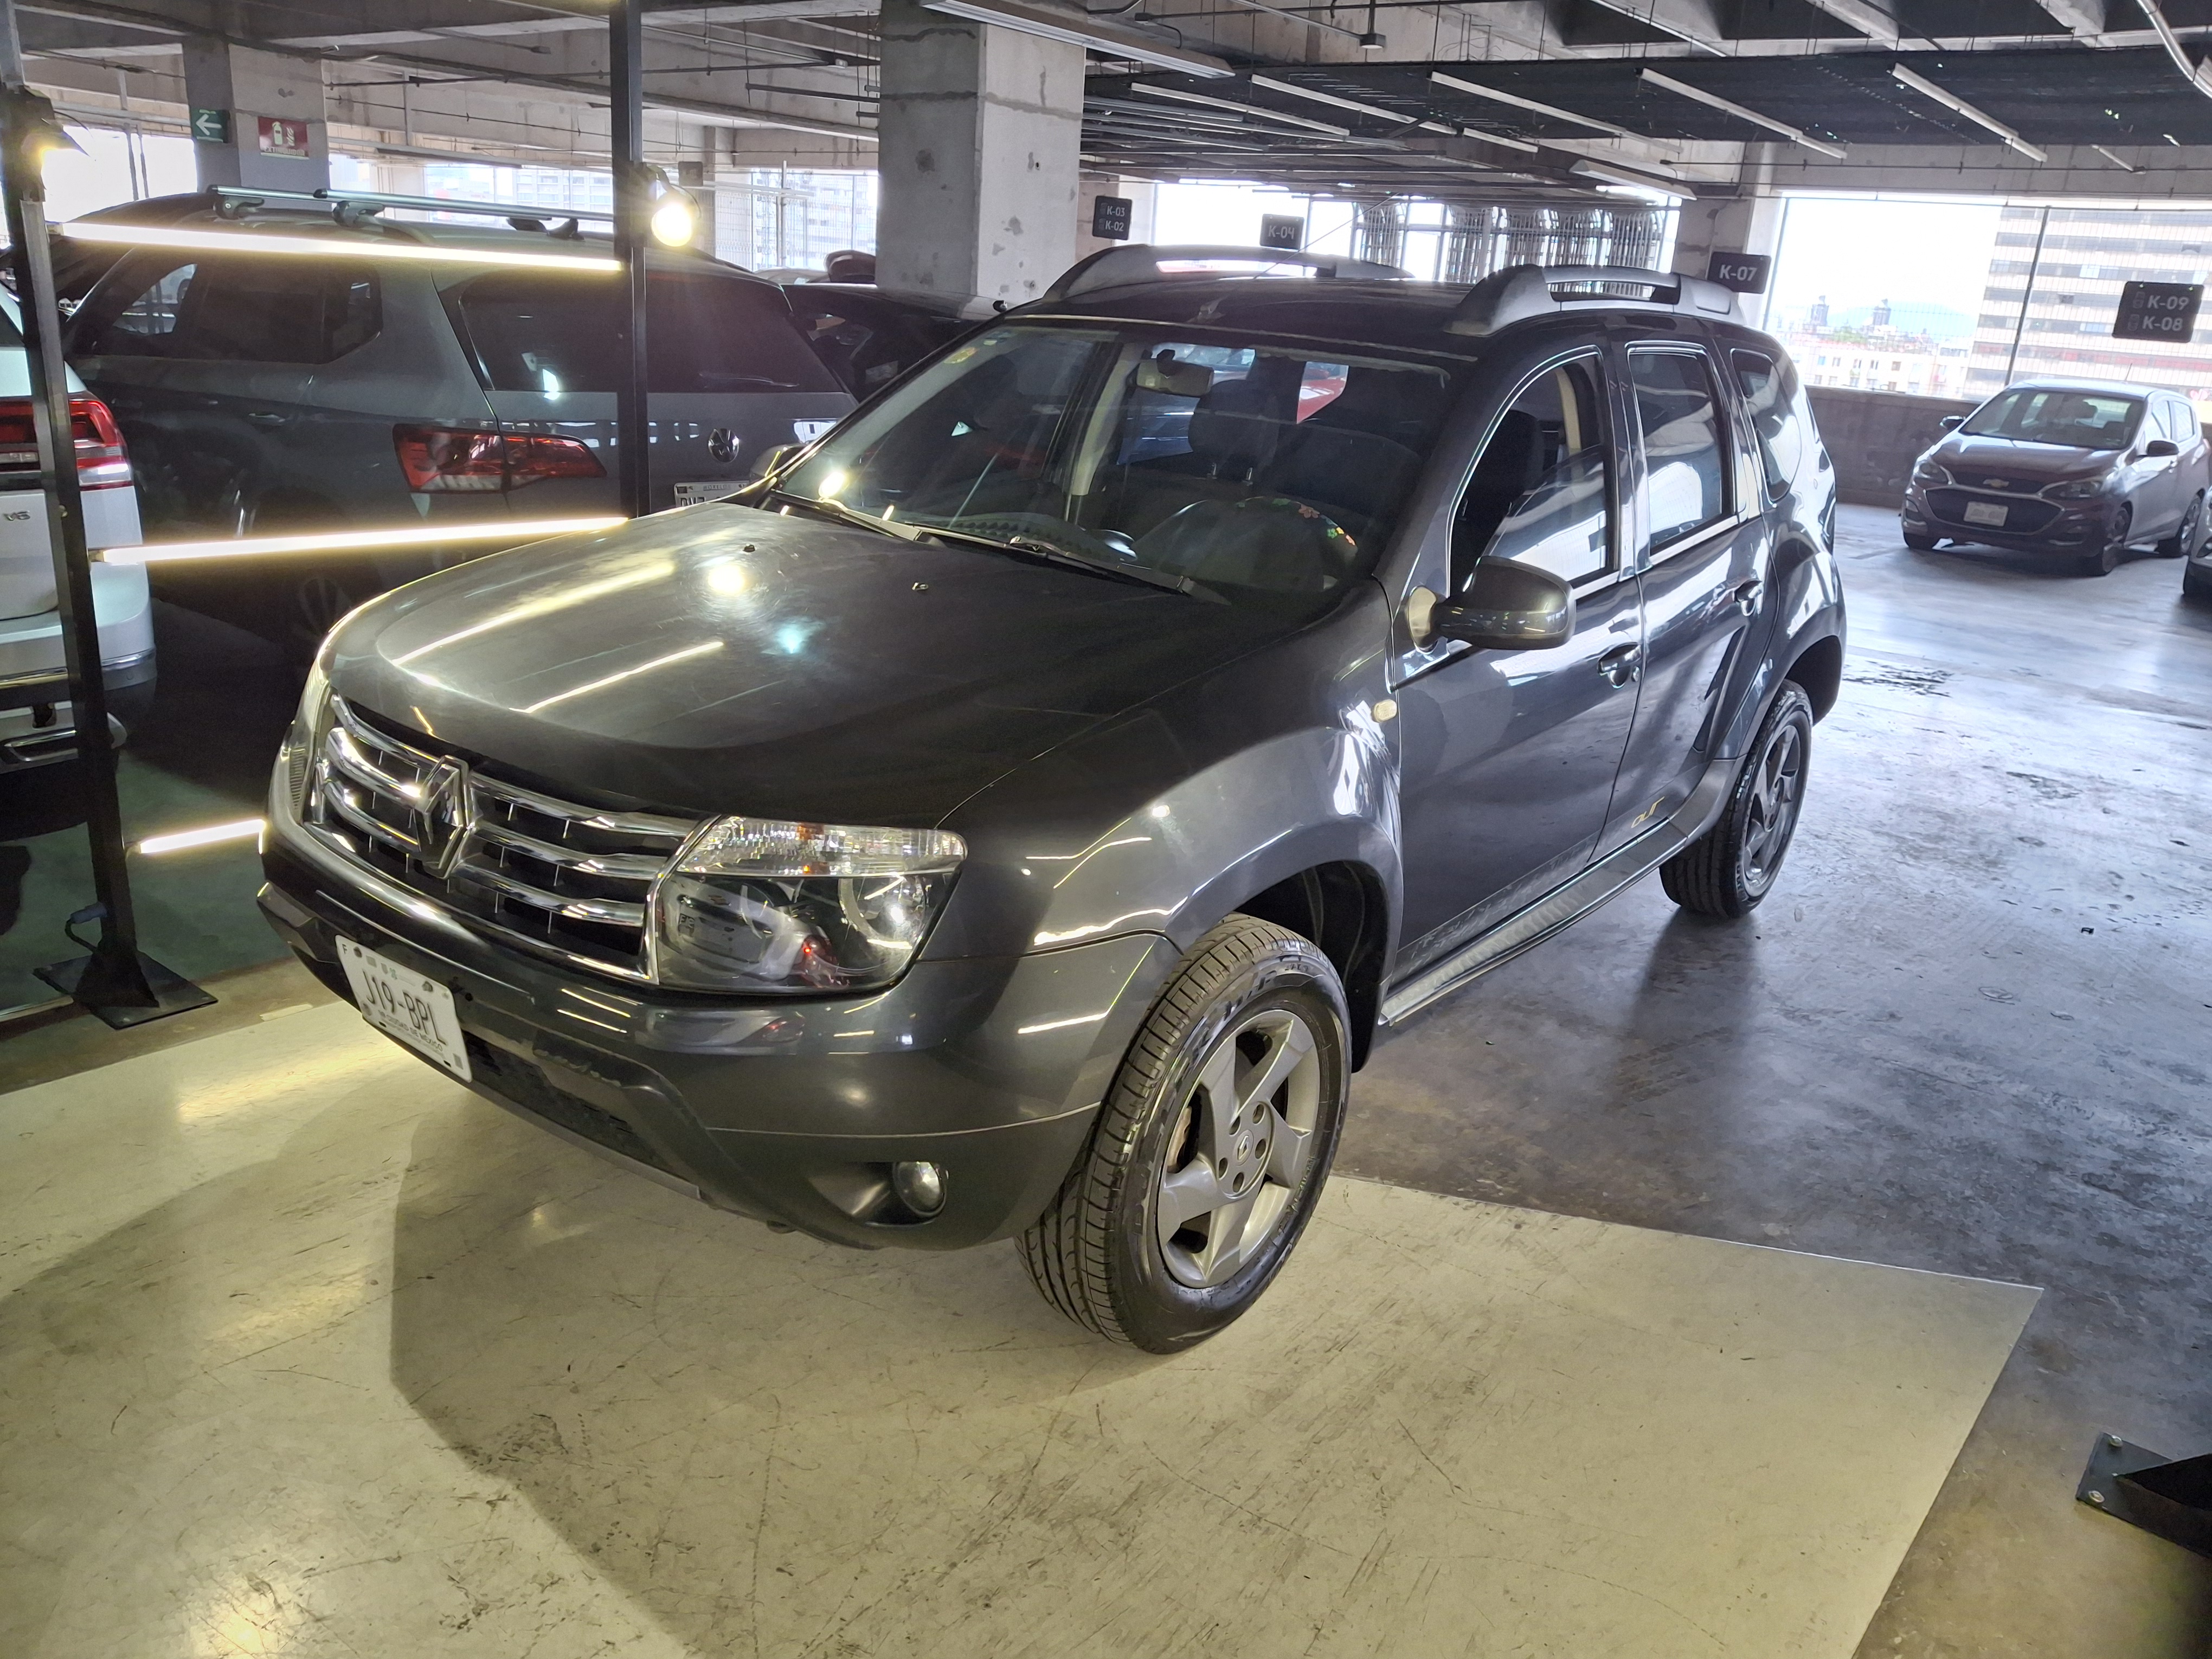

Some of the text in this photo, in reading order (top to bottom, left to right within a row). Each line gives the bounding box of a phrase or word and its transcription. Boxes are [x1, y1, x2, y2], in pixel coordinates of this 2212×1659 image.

[1107, 205, 1125, 217] K-03
[1105, 220, 1124, 232] K-02
[1269, 225, 1295, 239] K-04
[1719, 264, 1758, 281] K-07
[2147, 295, 2190, 311] K-09
[2142, 315, 2183, 332] K-08
[362, 968, 448, 1046] J19-BPL
